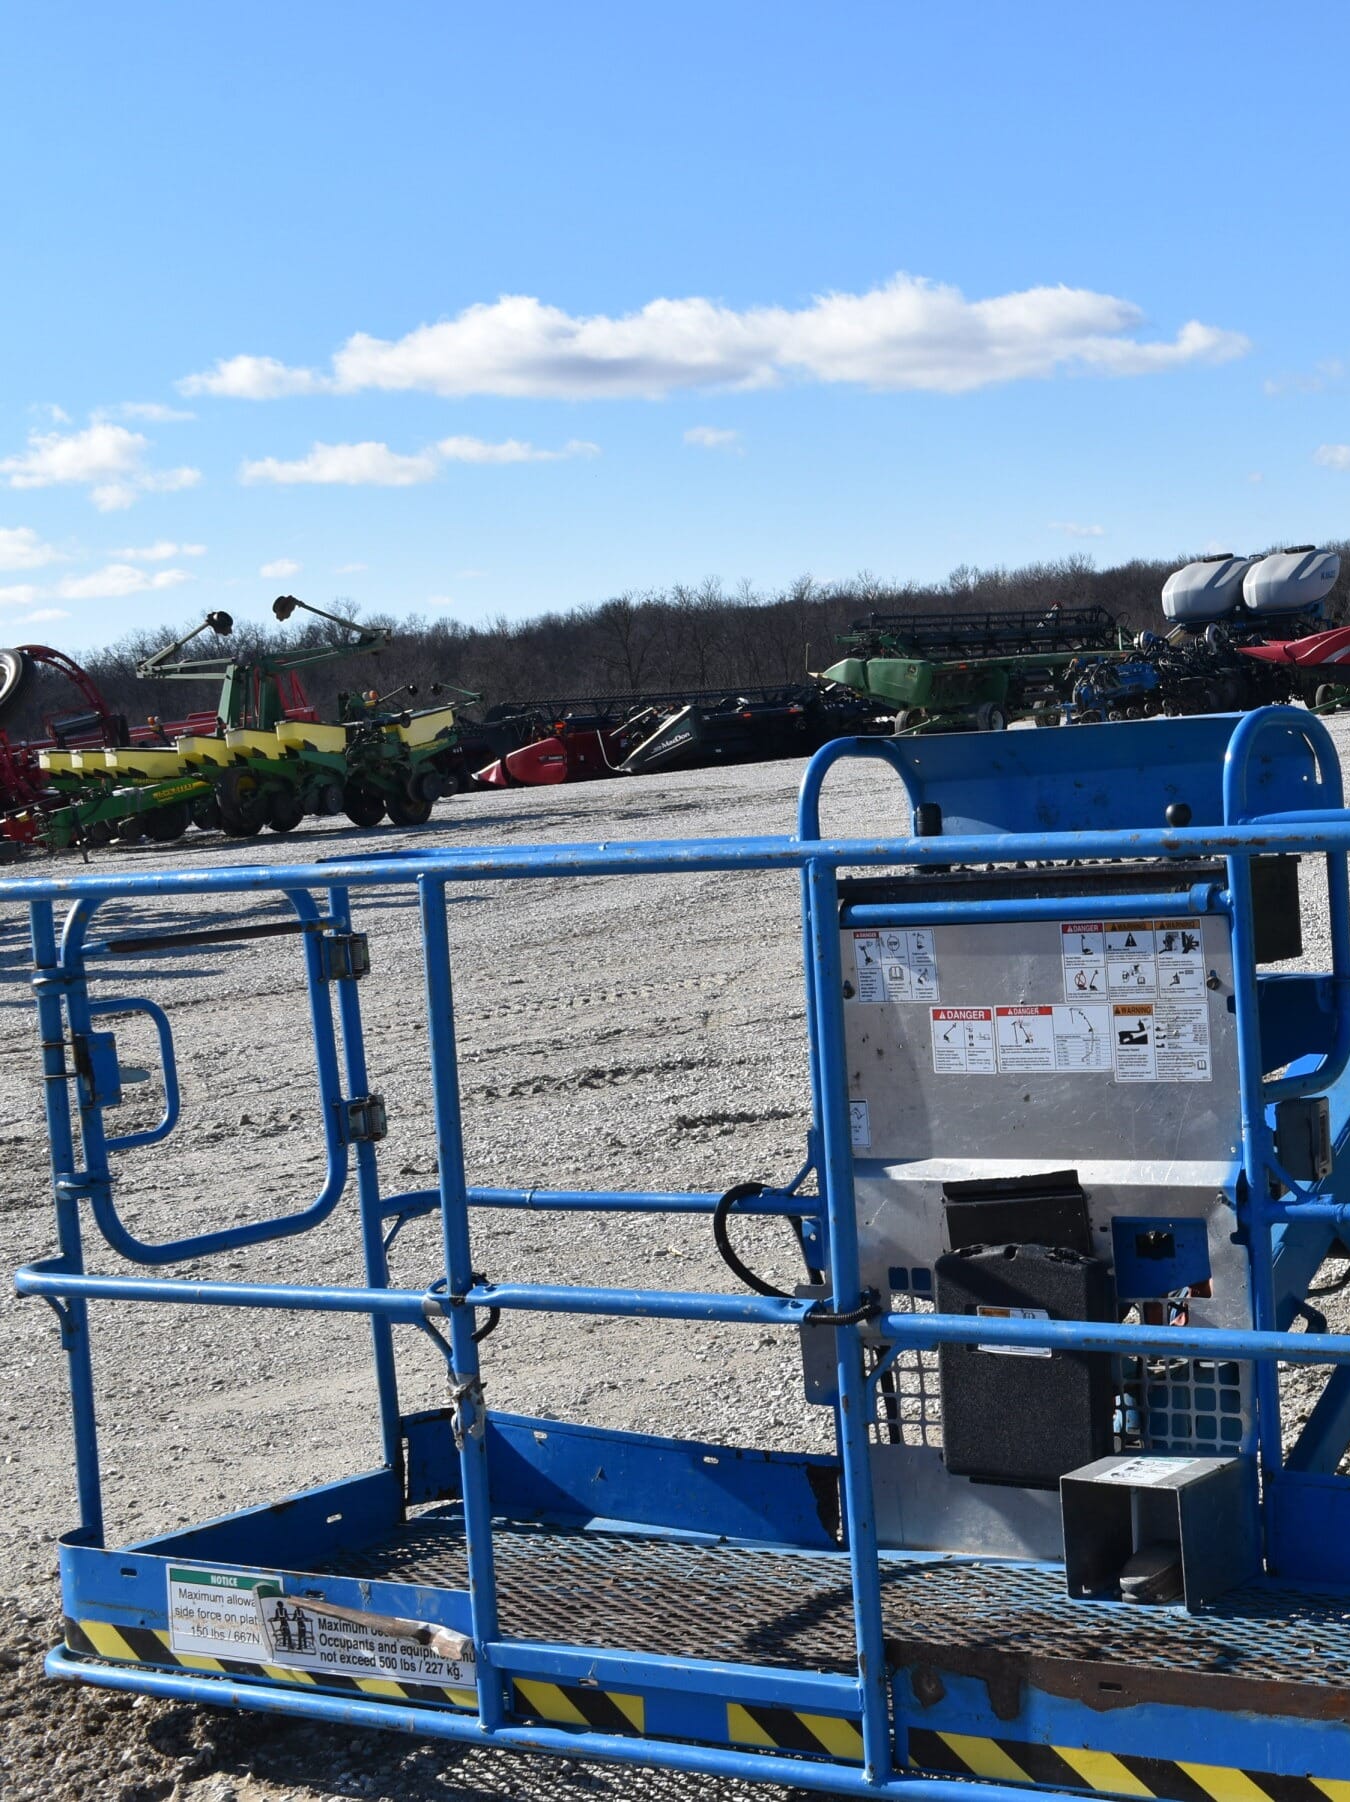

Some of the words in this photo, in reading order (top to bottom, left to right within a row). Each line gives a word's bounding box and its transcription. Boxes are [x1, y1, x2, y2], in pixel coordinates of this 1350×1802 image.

[946, 1010, 985, 1020] DANGER
[1120, 1006, 1151, 1015] WARNING
[210, 1574, 238, 1587] NOTICE
[178, 1588, 224, 1603] Maximum
[174, 1606, 195, 1617] side
[198, 1608, 222, 1621] force
[224, 1613, 237, 1622] on
[191, 1626, 208, 1637] 150
[211, 1628, 225, 1640] lbs
[318, 1618, 368, 1636] Maximum
[319, 1633, 375, 1652] Occupants
[378, 1641, 397, 1654] and
[320, 1651, 337, 1663] not
[339, 1653, 376, 1668] exceed
[379, 1655, 398, 1670] 500
[400, 1658, 416, 1673] lbs
[425, 1661, 443, 1675] 227
